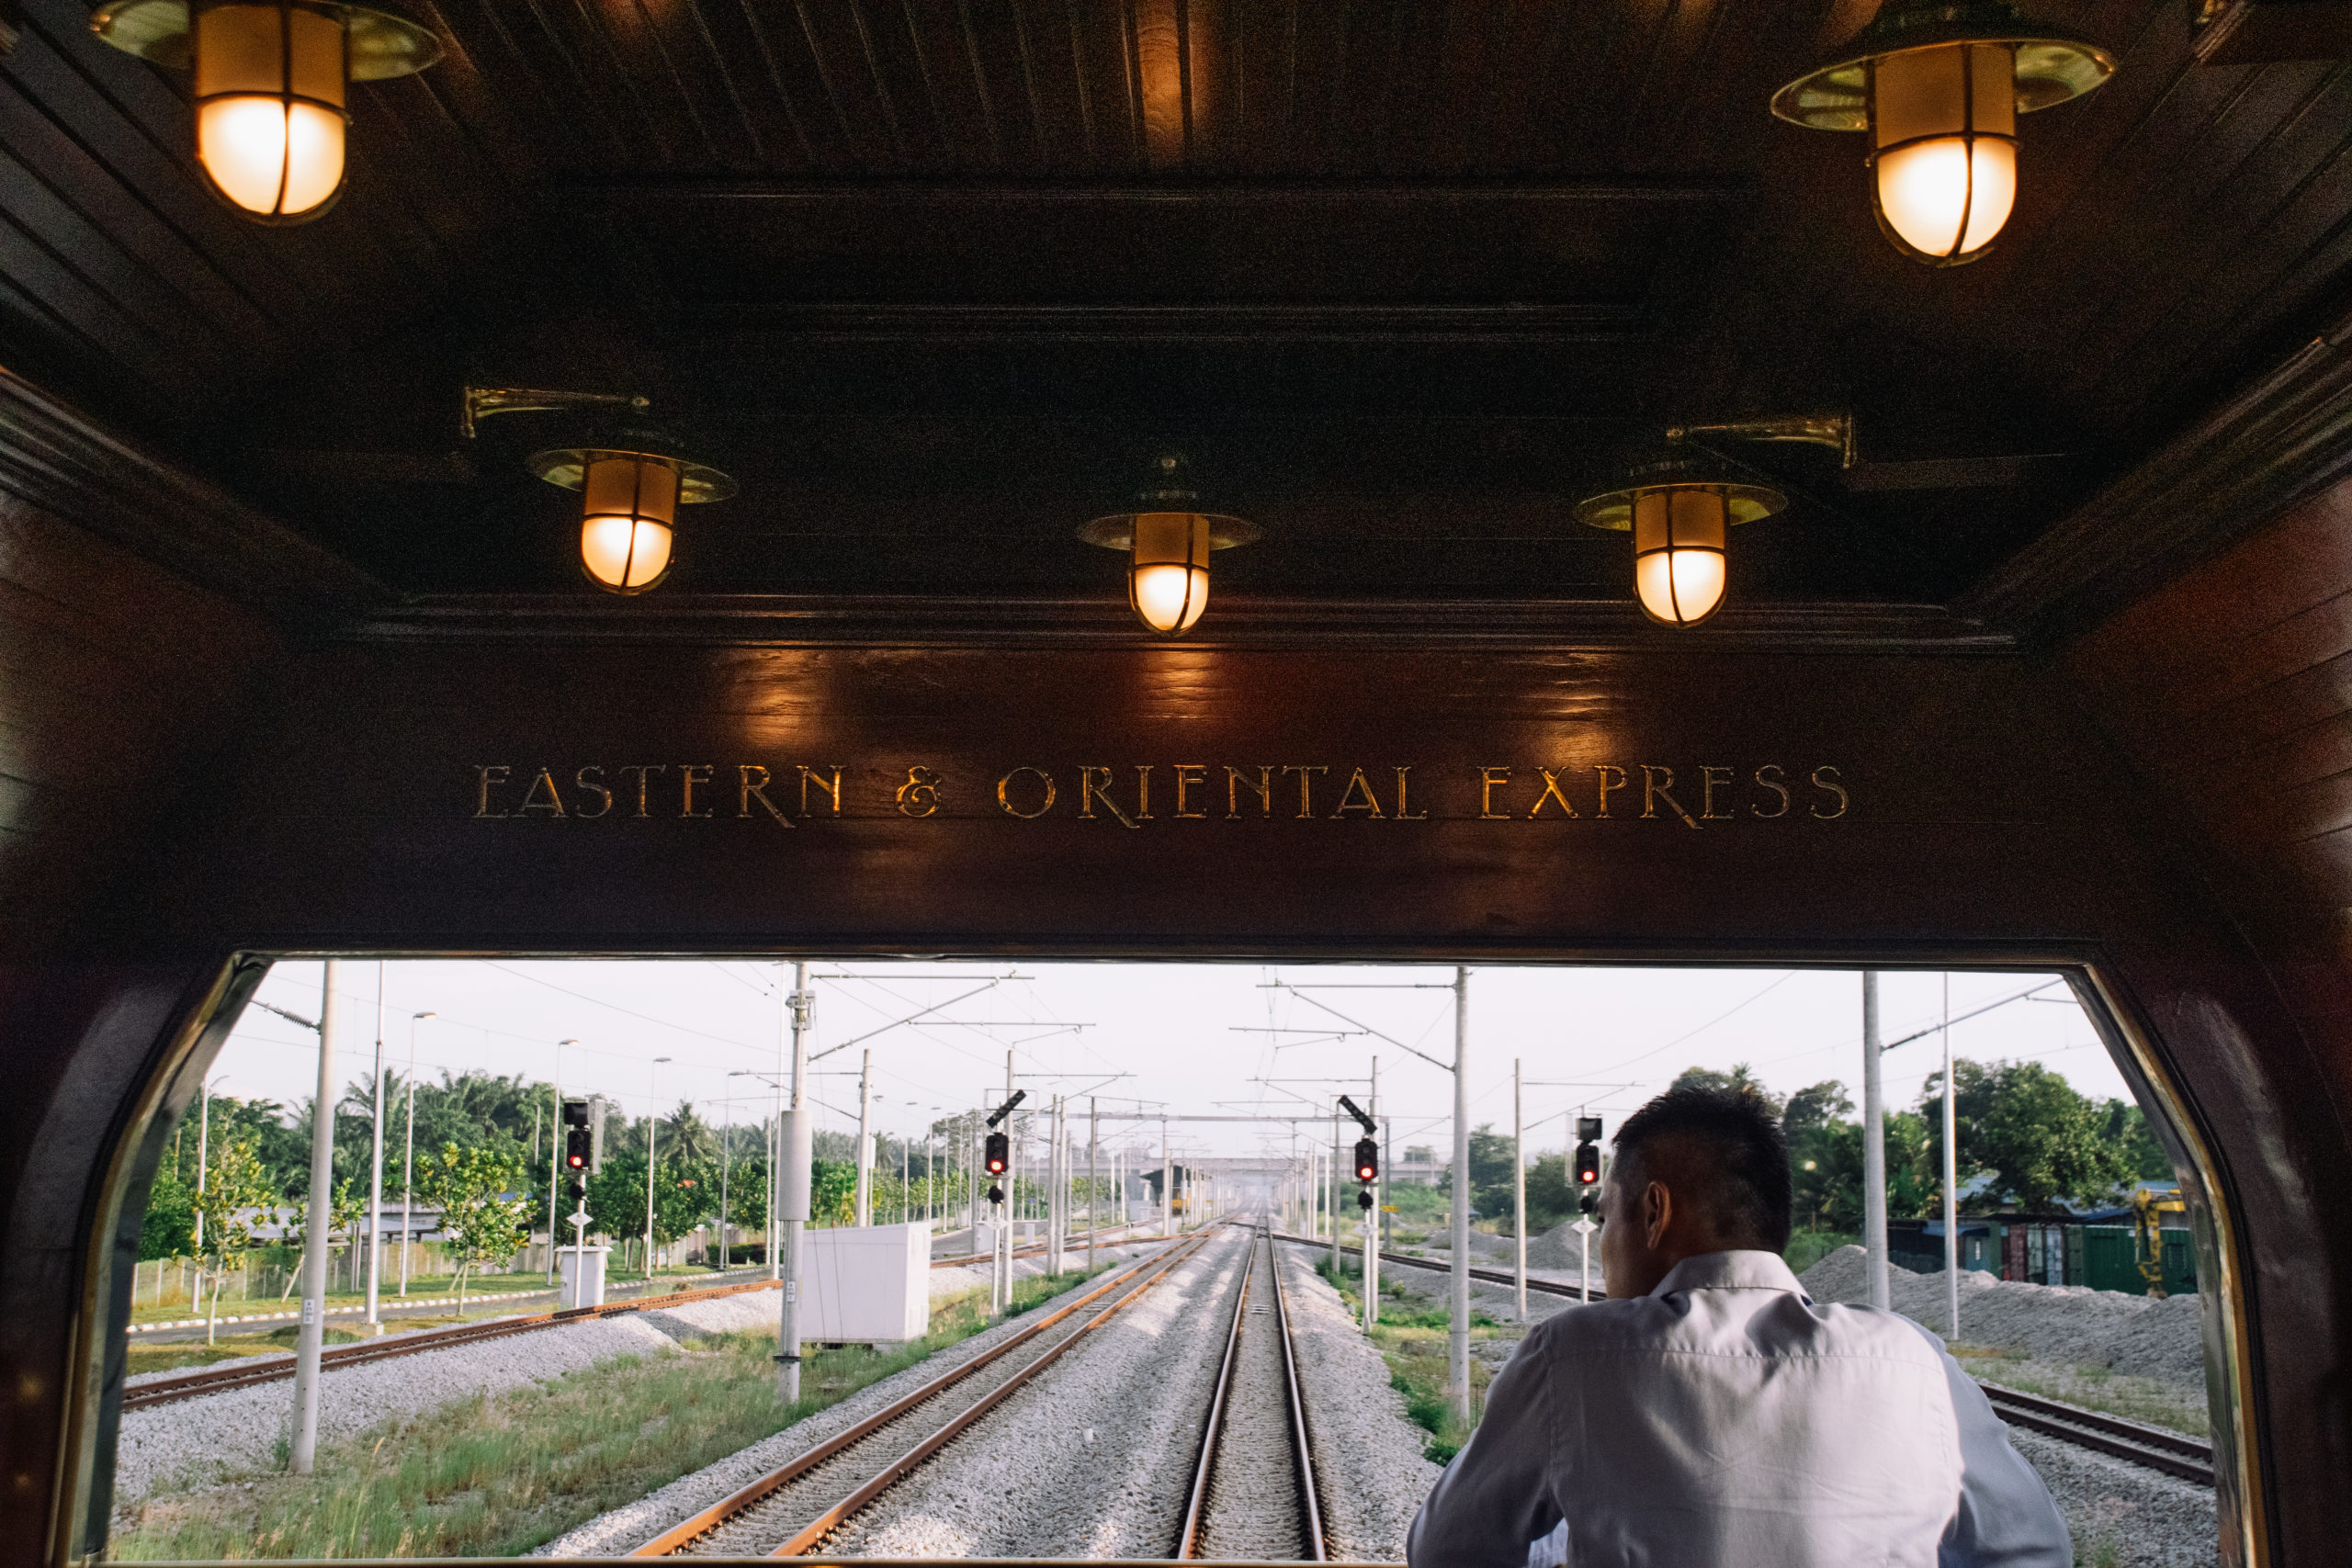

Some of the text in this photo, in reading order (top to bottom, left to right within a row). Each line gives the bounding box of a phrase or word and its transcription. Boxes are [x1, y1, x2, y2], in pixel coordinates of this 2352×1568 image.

[473, 764, 1850, 829] EASTERN & ORIENTAL EXPRESS
